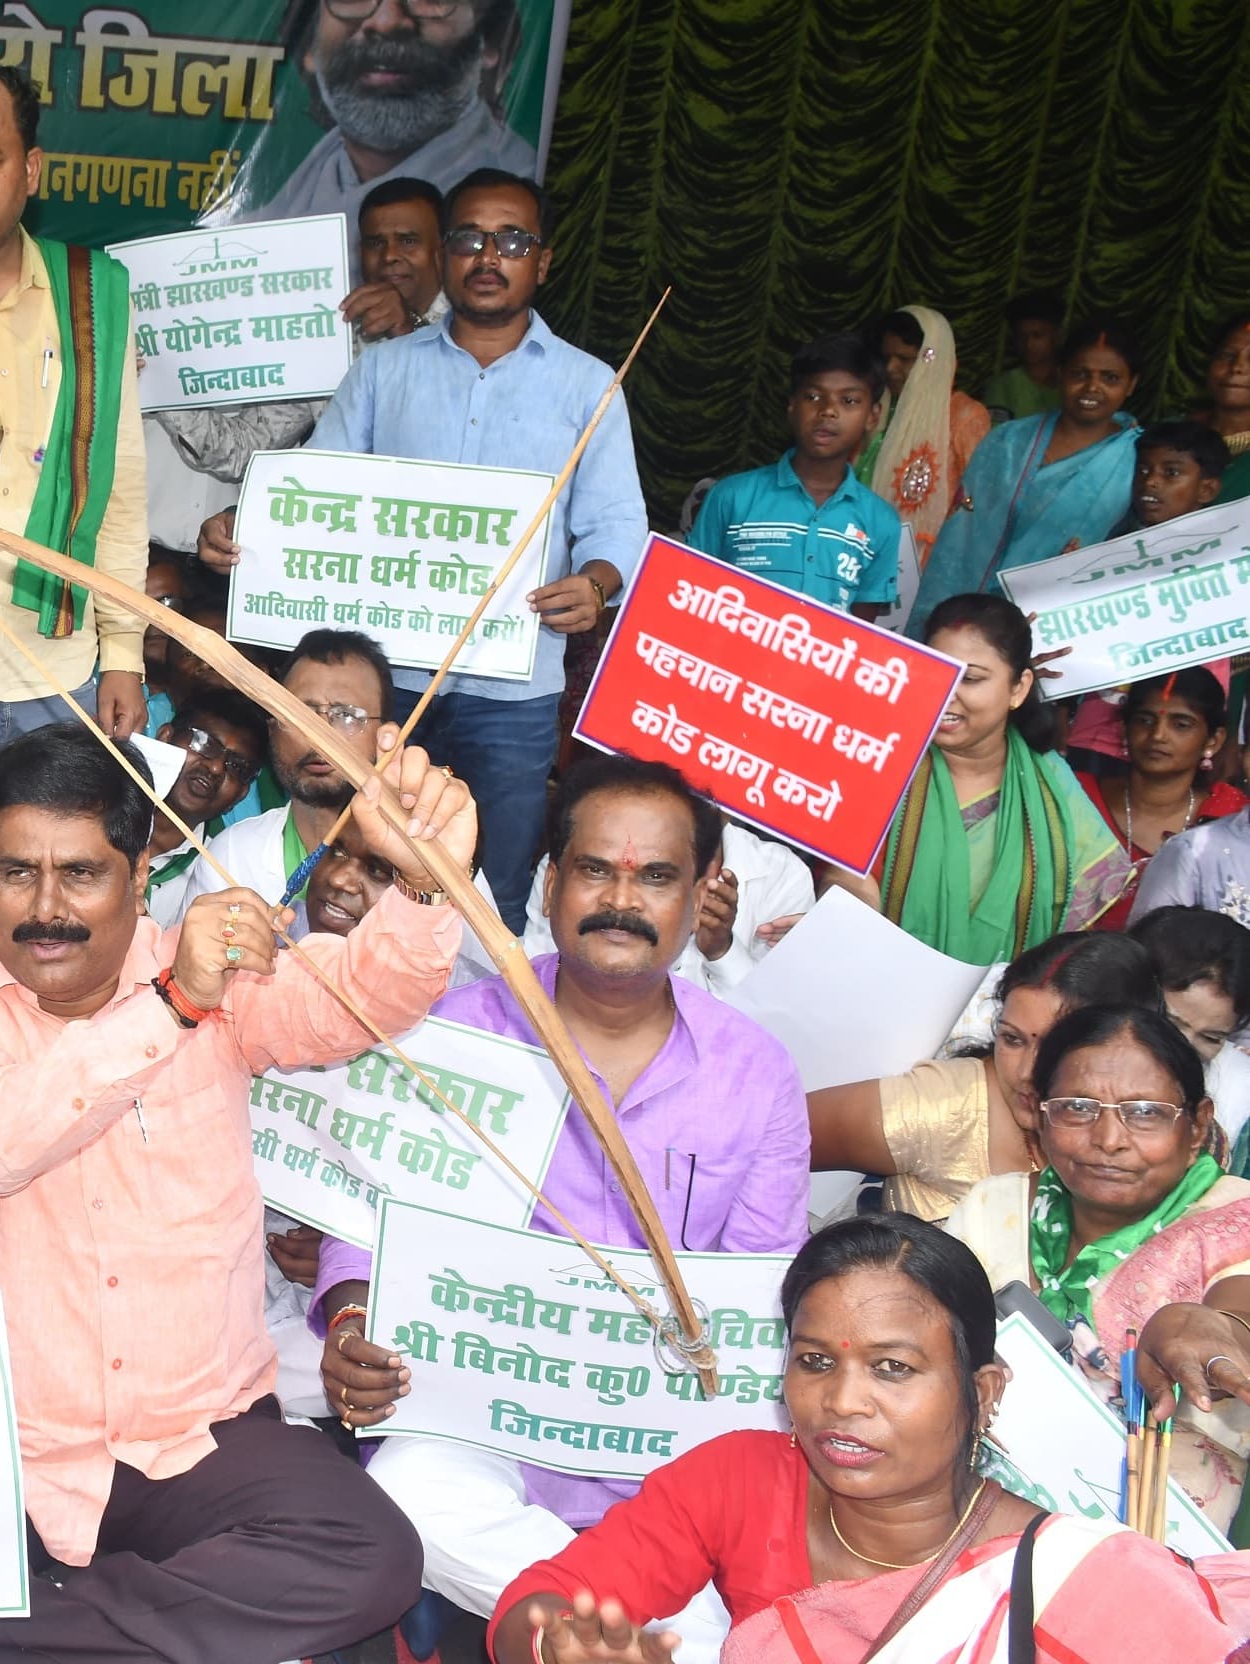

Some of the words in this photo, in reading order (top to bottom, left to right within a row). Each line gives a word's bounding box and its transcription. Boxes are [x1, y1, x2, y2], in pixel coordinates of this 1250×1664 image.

[75, 9, 285, 120] जिला
[164, 275, 255, 308] झारखण्ड
[258, 267, 334, 295] सरकार
[180, 257, 259, 276] JMM
[162, 317, 243, 354] योगेन्द्र
[248, 304, 337, 342] माहतो
[178, 362, 286, 396] जिन्दाबाद
[267, 476, 363, 533] केन्द्र
[372, 496, 518, 546] सरकार
[282, 547, 363, 585] सरना
[370, 550, 421, 589] धर्म
[427, 552, 495, 597] कोड
[1072, 538, 1222, 584] JMM
[243, 591, 329, 623] आदिवासी
[333, 598, 364, 626] धर्म
[366, 600, 405, 630] कोड
[407, 605, 435, 633] को
[667, 579, 859, 681] आदिवासियों
[853, 654, 910, 705] की
[1035, 584, 1152, 646] झारखण्ड
[1108, 617, 1250, 672] जिन्दाबाद
[635, 630, 742, 705] पहचान
[741, 681, 833, 746] सरना
[832, 720, 901, 774] धर्म
[631, 699, 700, 756] कोड
[697, 731, 774, 808] लागू
[773, 766, 843, 822] करो
[347, 1050, 525, 1137] सरकार
[283, 1143, 322, 1179] धर्म
[320, 1158, 365, 1200] कोड
[329, 1103, 396, 1162] धर्म
[398, 1128, 483, 1191] कोड
[428, 1267, 580, 1336] केन्द्रीय
[555, 1277, 656, 1298] JMM
[391, 1319, 446, 1364] श्री
[451, 1331, 577, 1390] बिनोद
[488, 1398, 679, 1458] जिन्दाबाद
